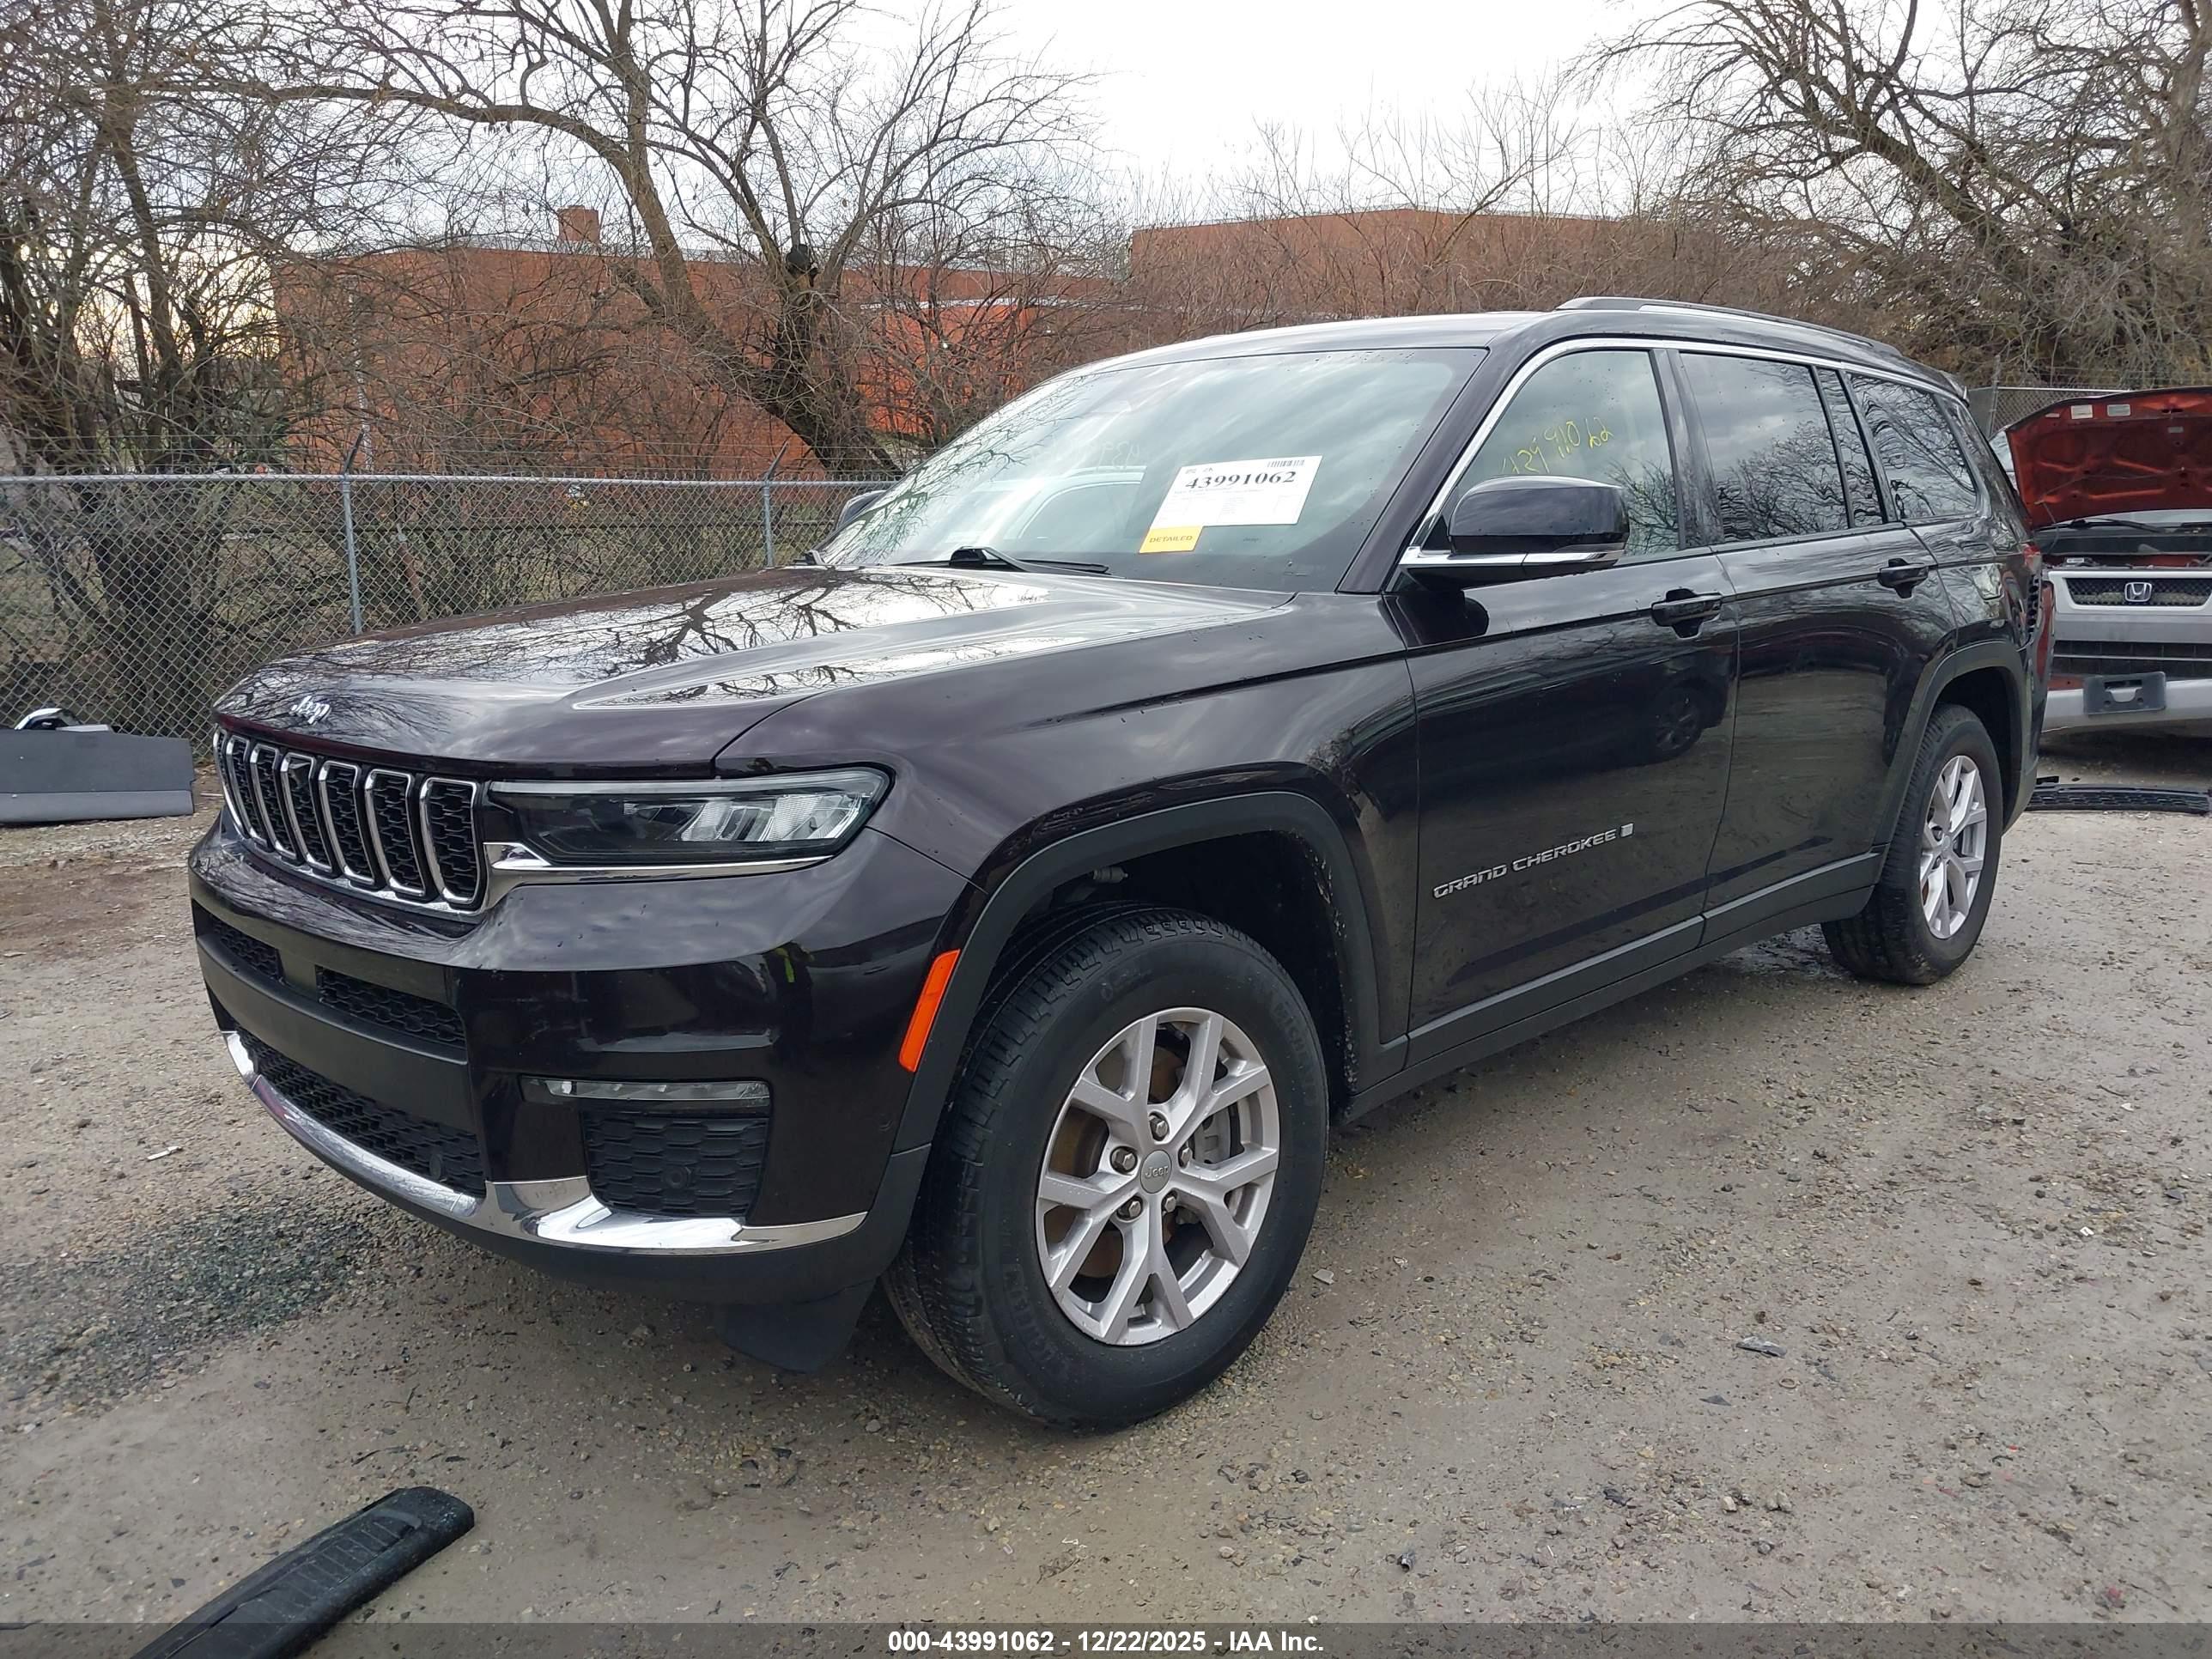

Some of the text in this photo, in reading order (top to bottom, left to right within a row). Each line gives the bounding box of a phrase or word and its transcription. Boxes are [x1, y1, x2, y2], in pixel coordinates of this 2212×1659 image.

[1185, 471, 1297, 489] 43991062
[1148, 534, 1194, 544] DETAILED
[1432, 828, 1618, 899] GRAND CHEROKEE
[1145, 1165, 1169, 1181] Jeep
